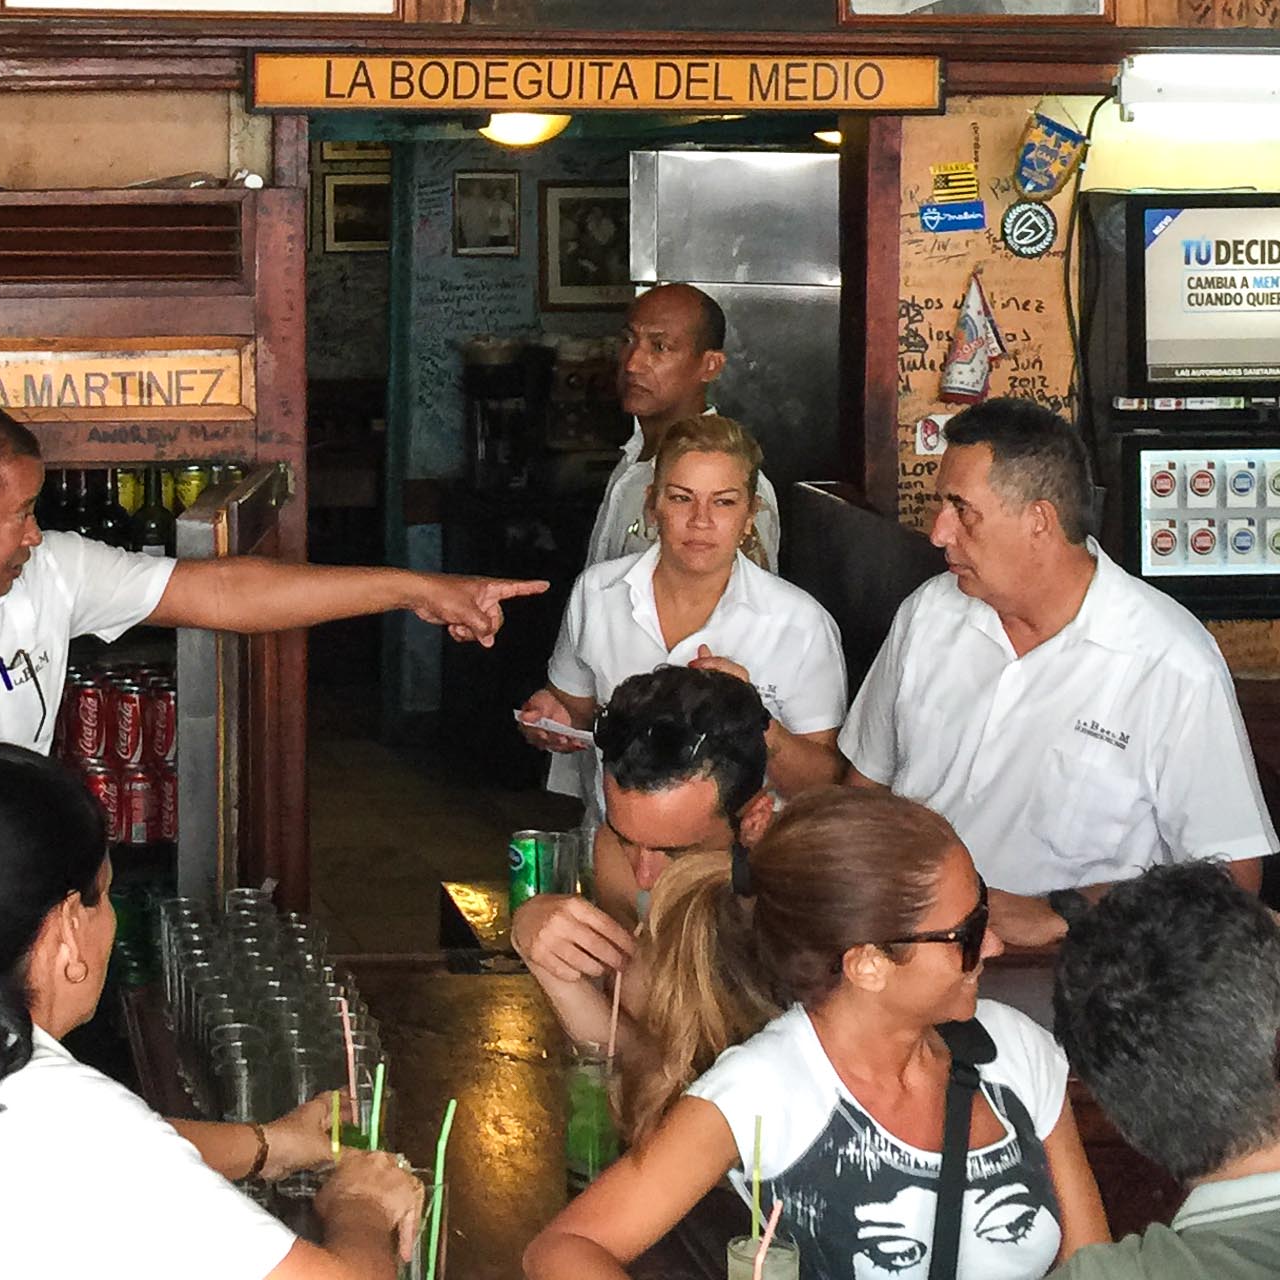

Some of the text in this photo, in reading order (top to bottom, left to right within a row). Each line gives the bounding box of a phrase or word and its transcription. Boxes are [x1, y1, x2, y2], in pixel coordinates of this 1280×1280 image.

[324, 61, 885, 102] LA BODEGUITA DEL MEDIO
[1181, 235, 1213, 266] TÚ
[1187, 276, 1236, 290] CAMBIA
[1240, 276, 1249, 290] A
[1187, 292, 1243, 307] CUANDO
[23, 368, 231, 407] MARTINEZ
